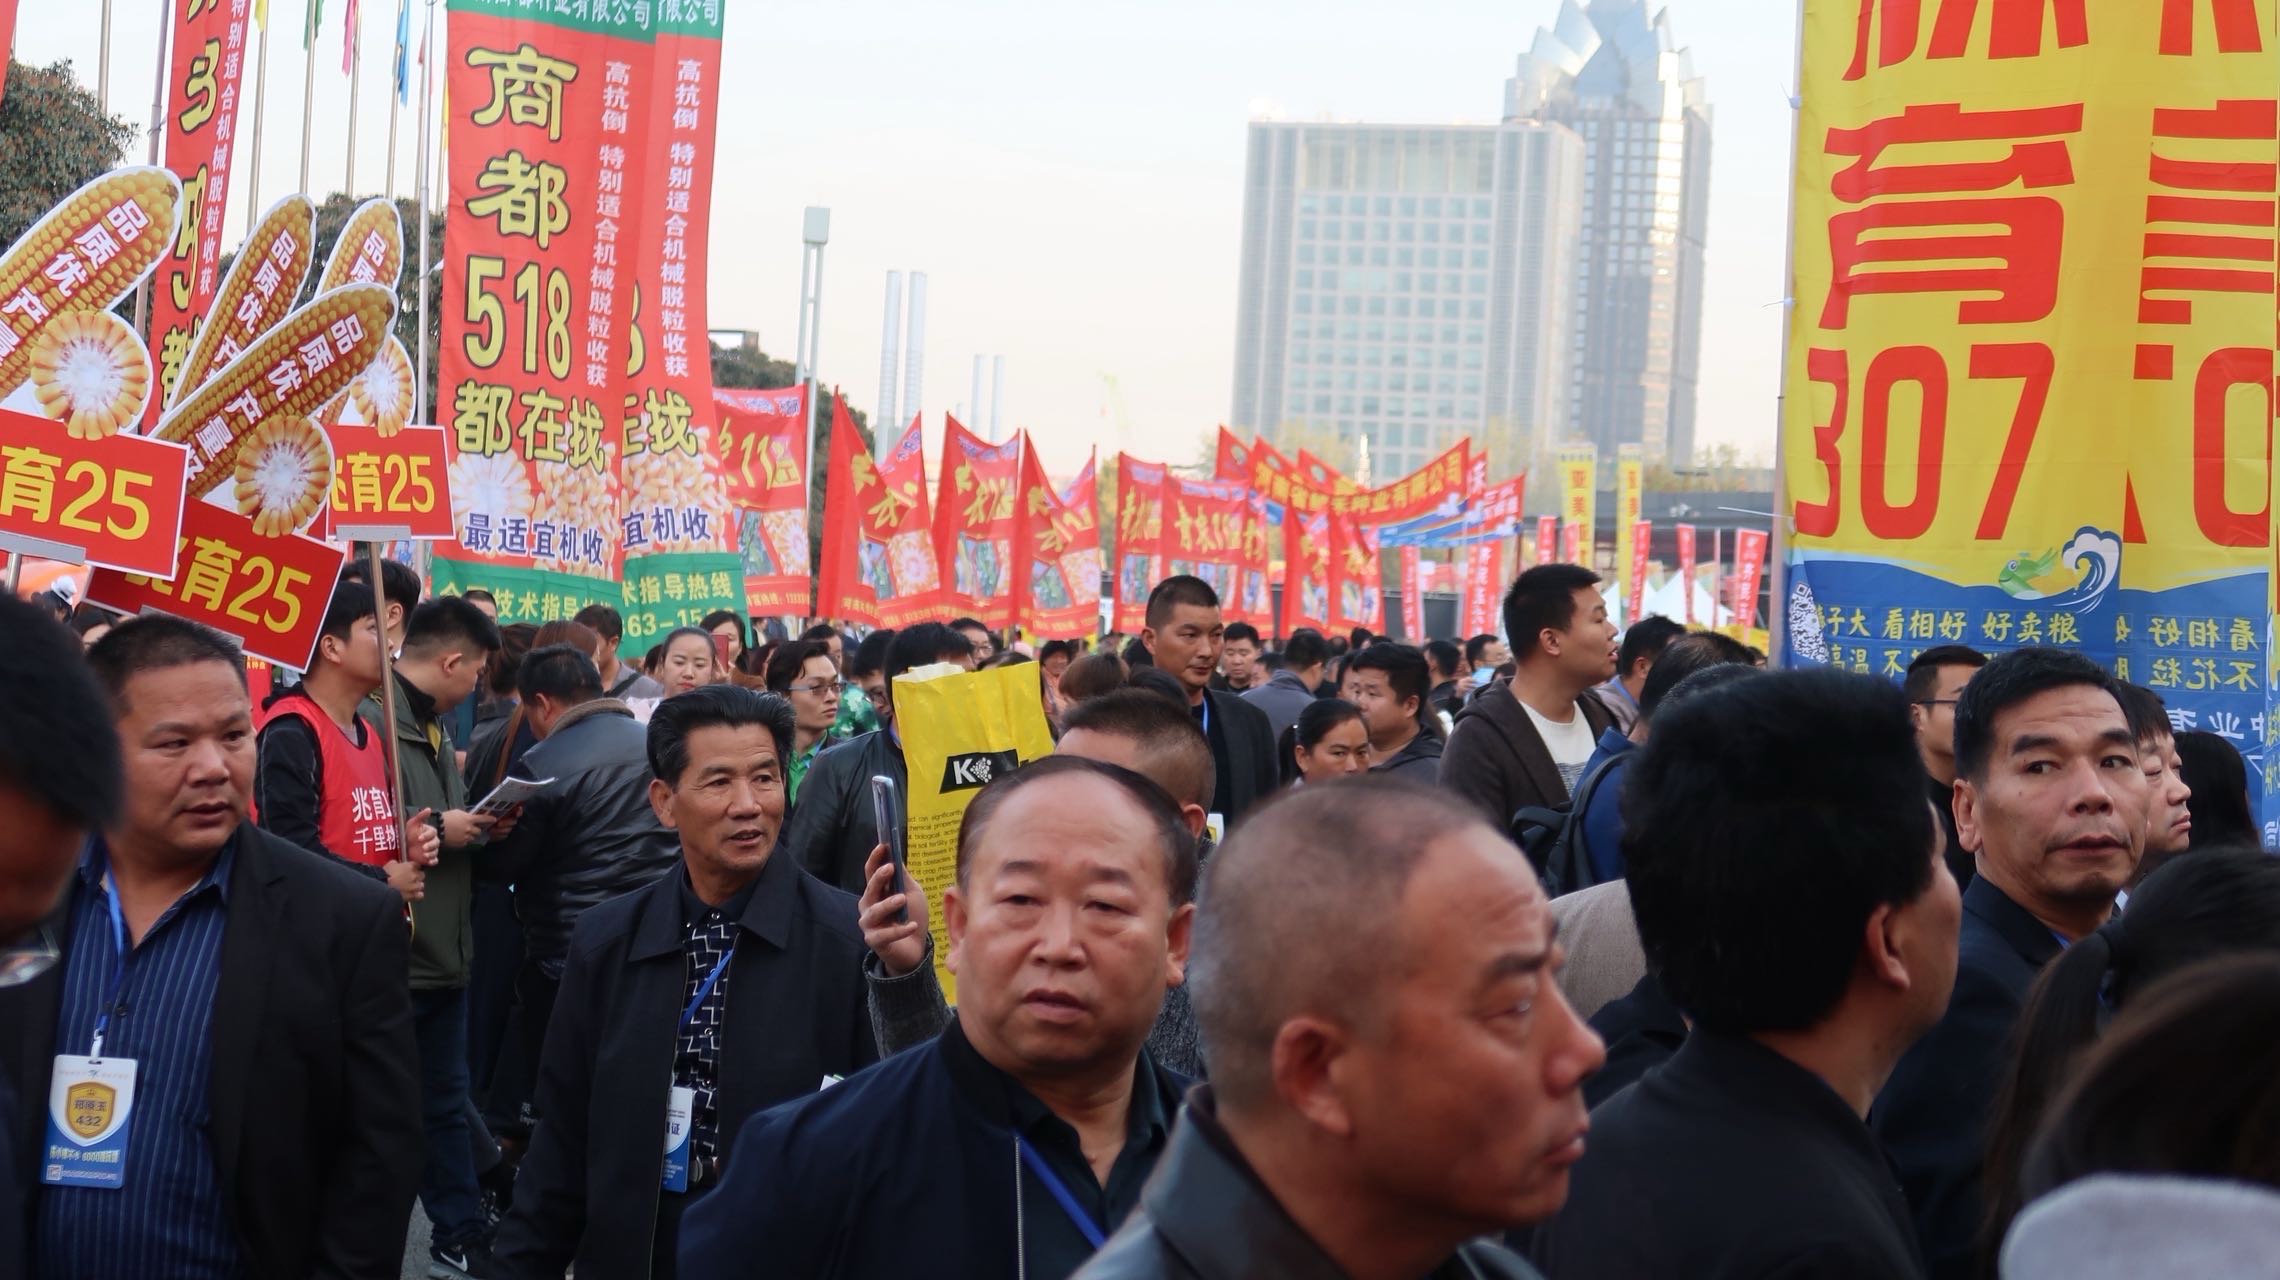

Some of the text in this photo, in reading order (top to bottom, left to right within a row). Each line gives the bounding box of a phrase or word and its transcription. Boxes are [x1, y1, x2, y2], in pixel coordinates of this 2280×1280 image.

[585, 60, 632, 389] 高抗倒 特别适合机械脱粒收获
[660, 58, 702, 378] 高抗倒 特别适合机械脱粒收获
[205, 228, 299, 383] 品质优产
[464, 254, 573, 380] 518
[453, 380, 605, 475] 都在找
[0, 446, 153, 541] 育25
[464, 513, 604, 566] 最适宜机收
[621, 507, 712, 549] 宜机收
[440, 582, 612, 621] 技术指导
[1883, 608, 1967, 641] 看相好
[1982, 611, 2081, 644] 好卖粮
[953, 758, 977, 785] K
